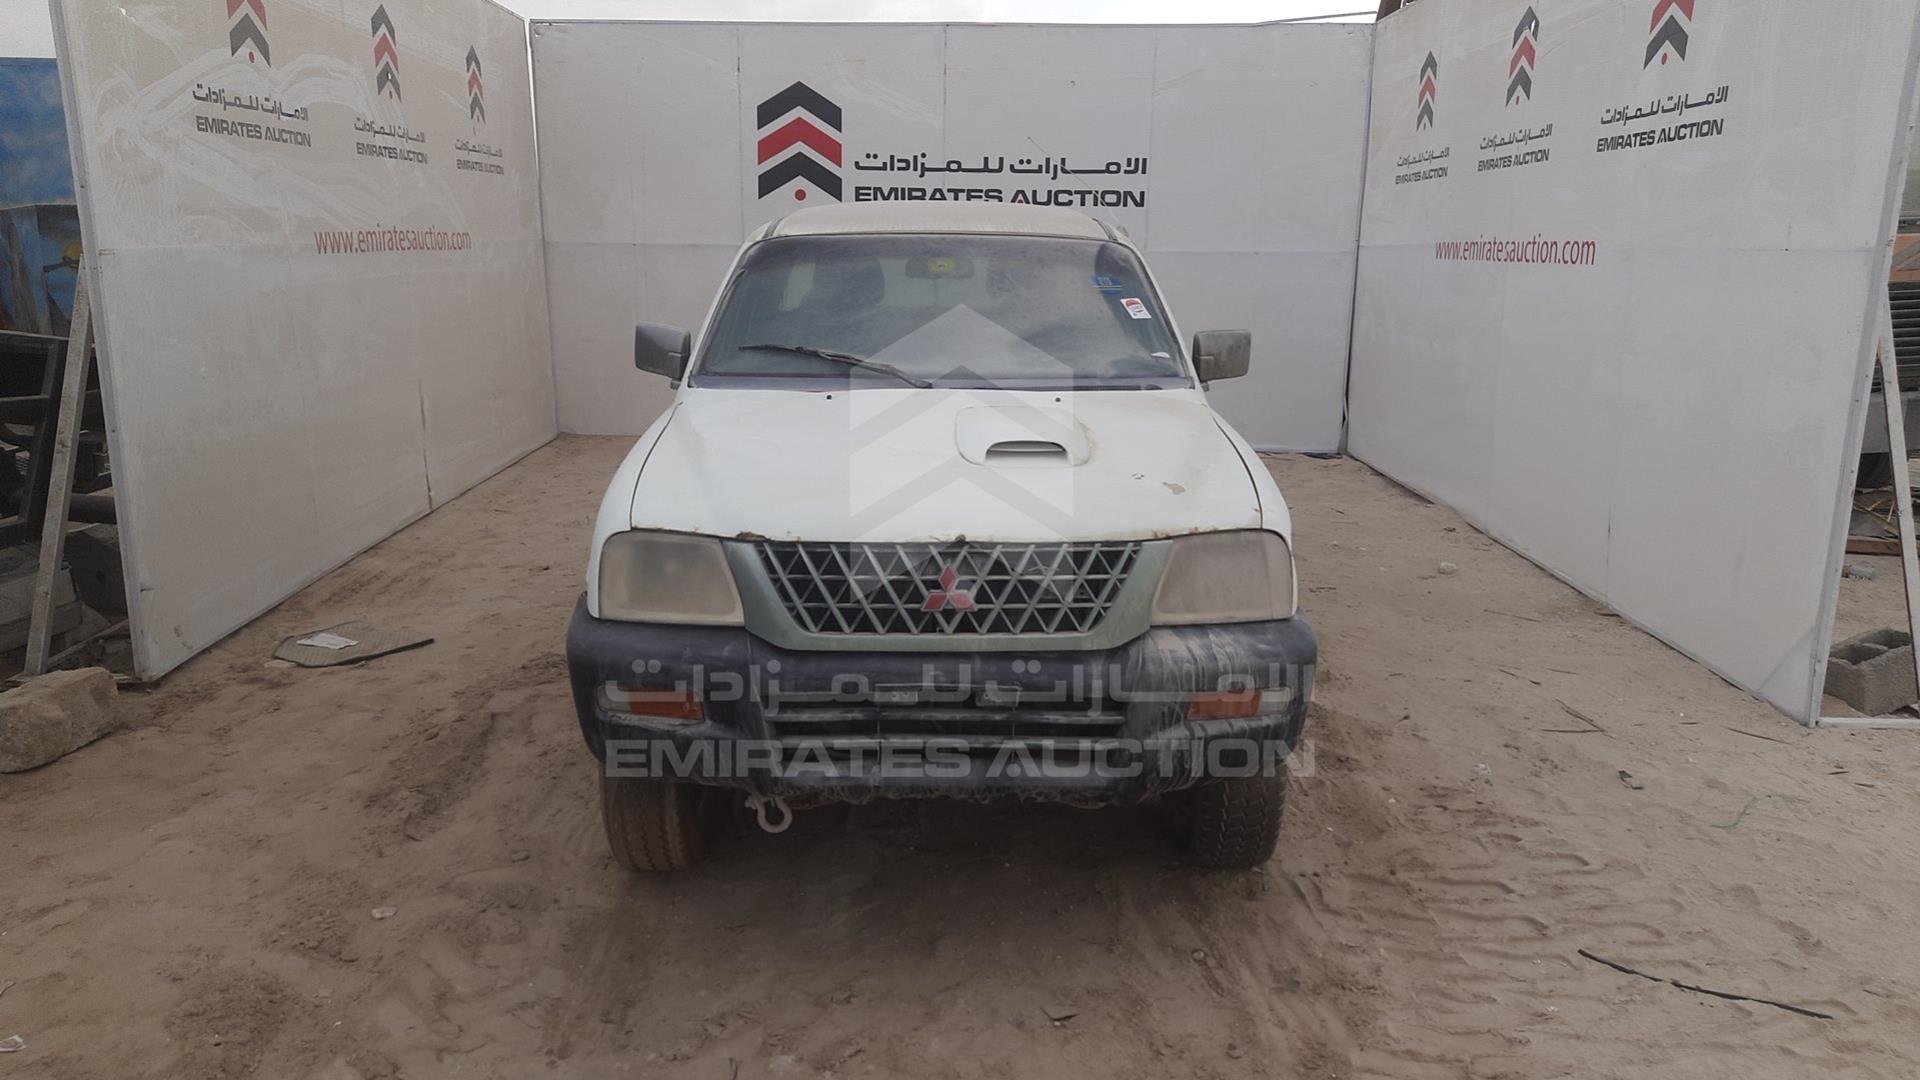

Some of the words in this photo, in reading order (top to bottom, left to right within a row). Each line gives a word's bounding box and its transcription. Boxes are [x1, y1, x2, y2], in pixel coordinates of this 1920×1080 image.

[195, 115, 262, 140] EMIRATES
[264, 126, 312, 147] AUCTION
[1596, 129, 1656, 152] EMIRATES
[1657, 118, 1724, 144] AUCTION
[356, 142, 398, 159] EMIRATES
[399, 149, 428, 164] AUCTION
[1477, 155, 1512, 172] EMIRATES
[1513, 148, 1549, 167] AUCTION
[854, 186, 1003, 203] EMIRATES
[1010, 189, 1146, 208] AUCTION
[314, 223, 472, 255] www.emiratesauction.com
[1435, 233, 1596, 266] www.emiratesauction.com
